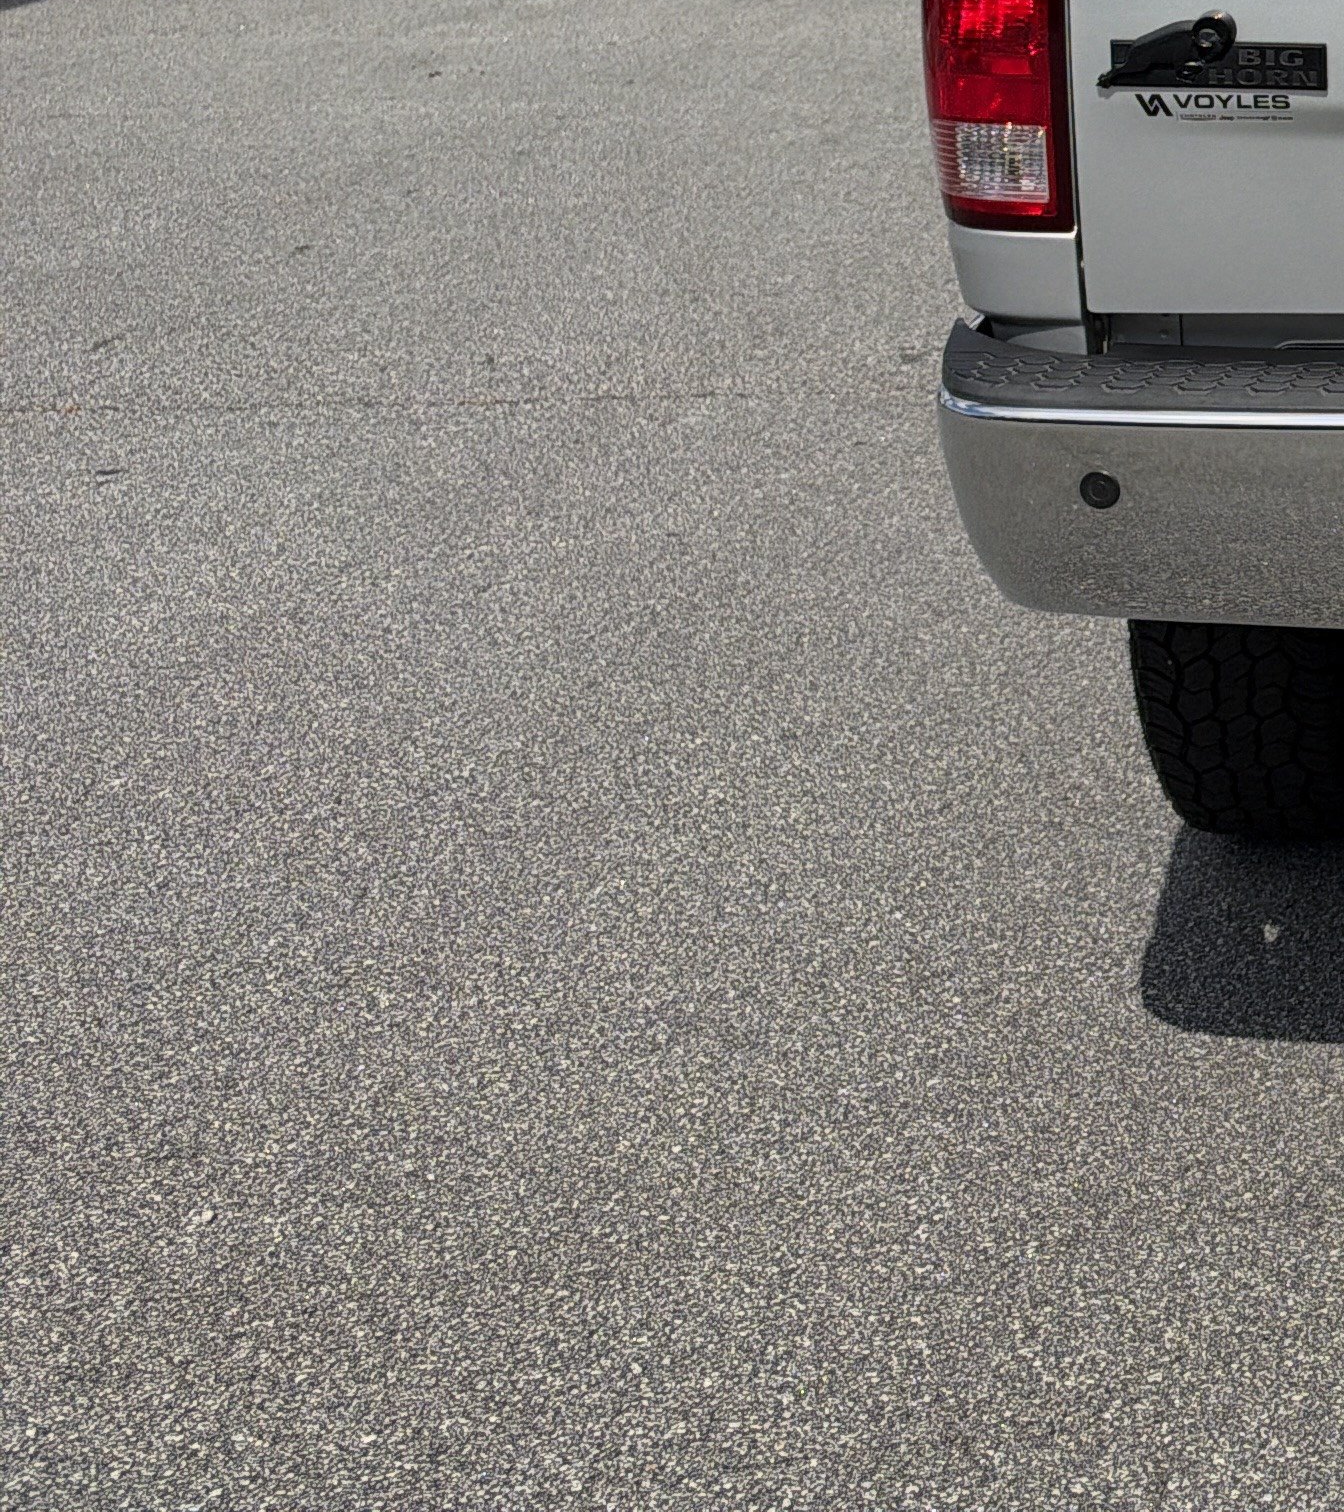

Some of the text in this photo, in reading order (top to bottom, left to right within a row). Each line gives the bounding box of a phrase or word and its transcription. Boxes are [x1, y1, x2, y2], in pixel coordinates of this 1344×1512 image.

[1238, 48, 1304, 67] BIG
[1208, 68, 1318, 86] HORN
[1173, 93, 1291, 110] VOYLES
